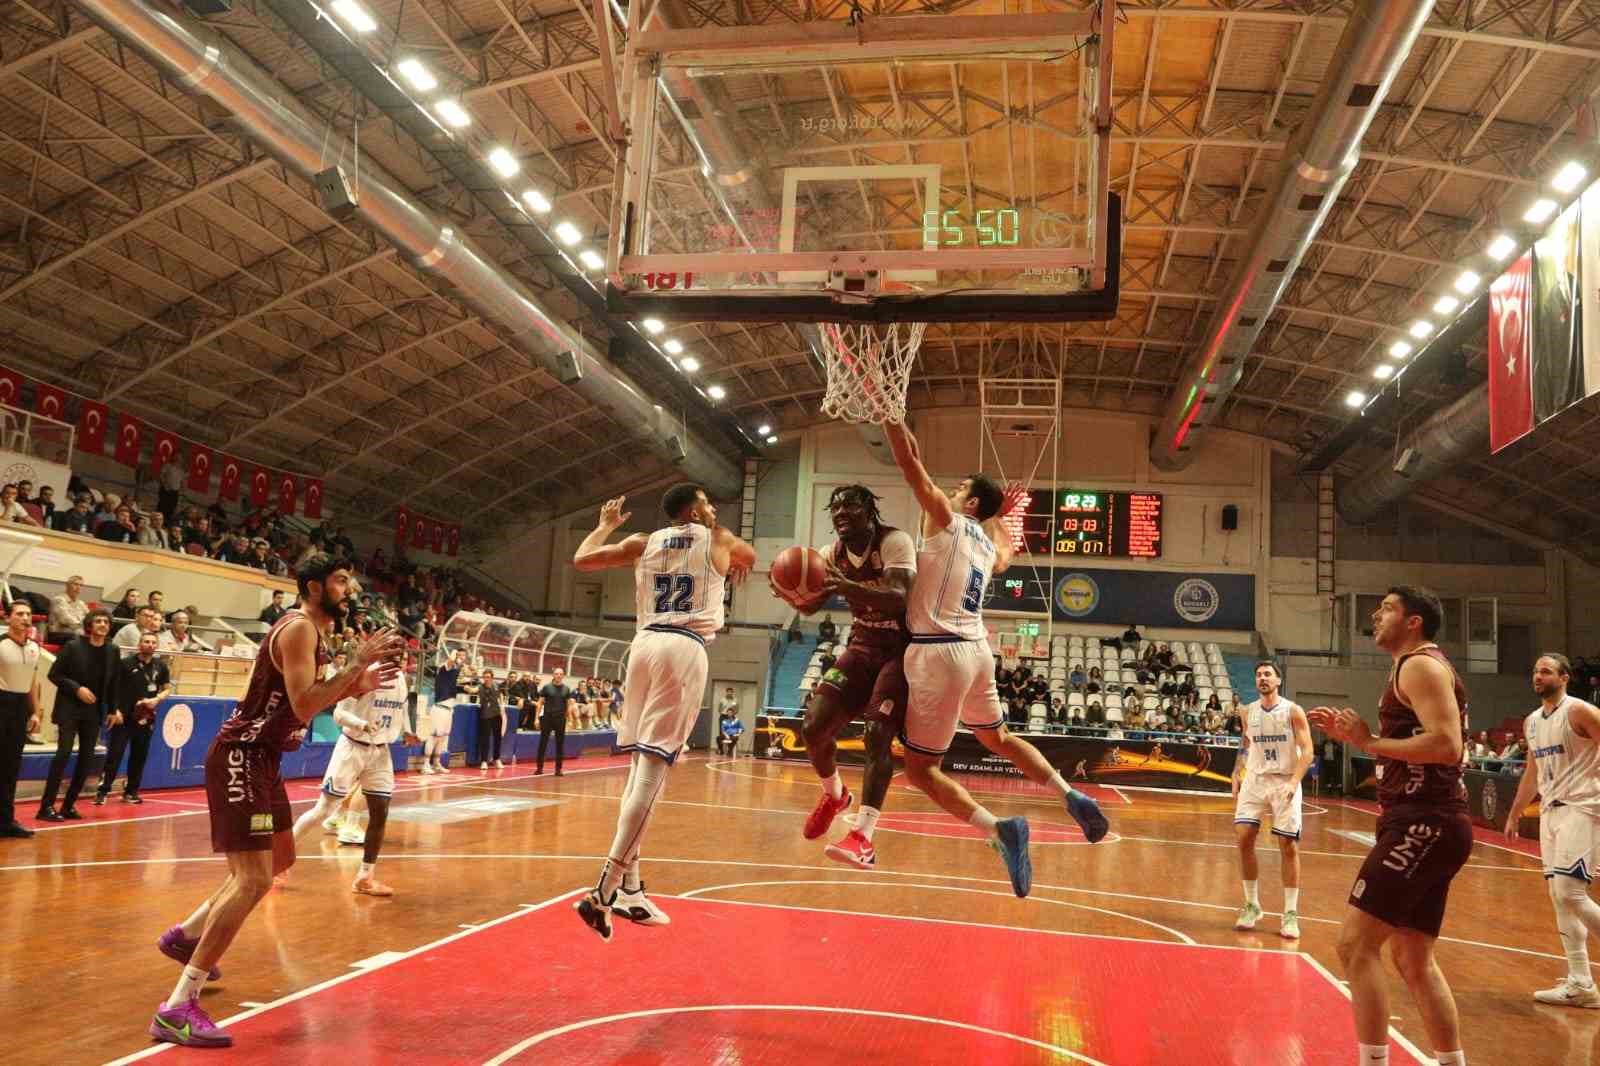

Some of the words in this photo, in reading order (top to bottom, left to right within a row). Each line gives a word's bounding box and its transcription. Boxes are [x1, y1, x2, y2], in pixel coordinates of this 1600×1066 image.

[1064, 518, 1078, 531] 03
[1083, 519, 1097, 532] 03
[1056, 540, 1076, 552] 009
[655, 574, 694, 614] 22
